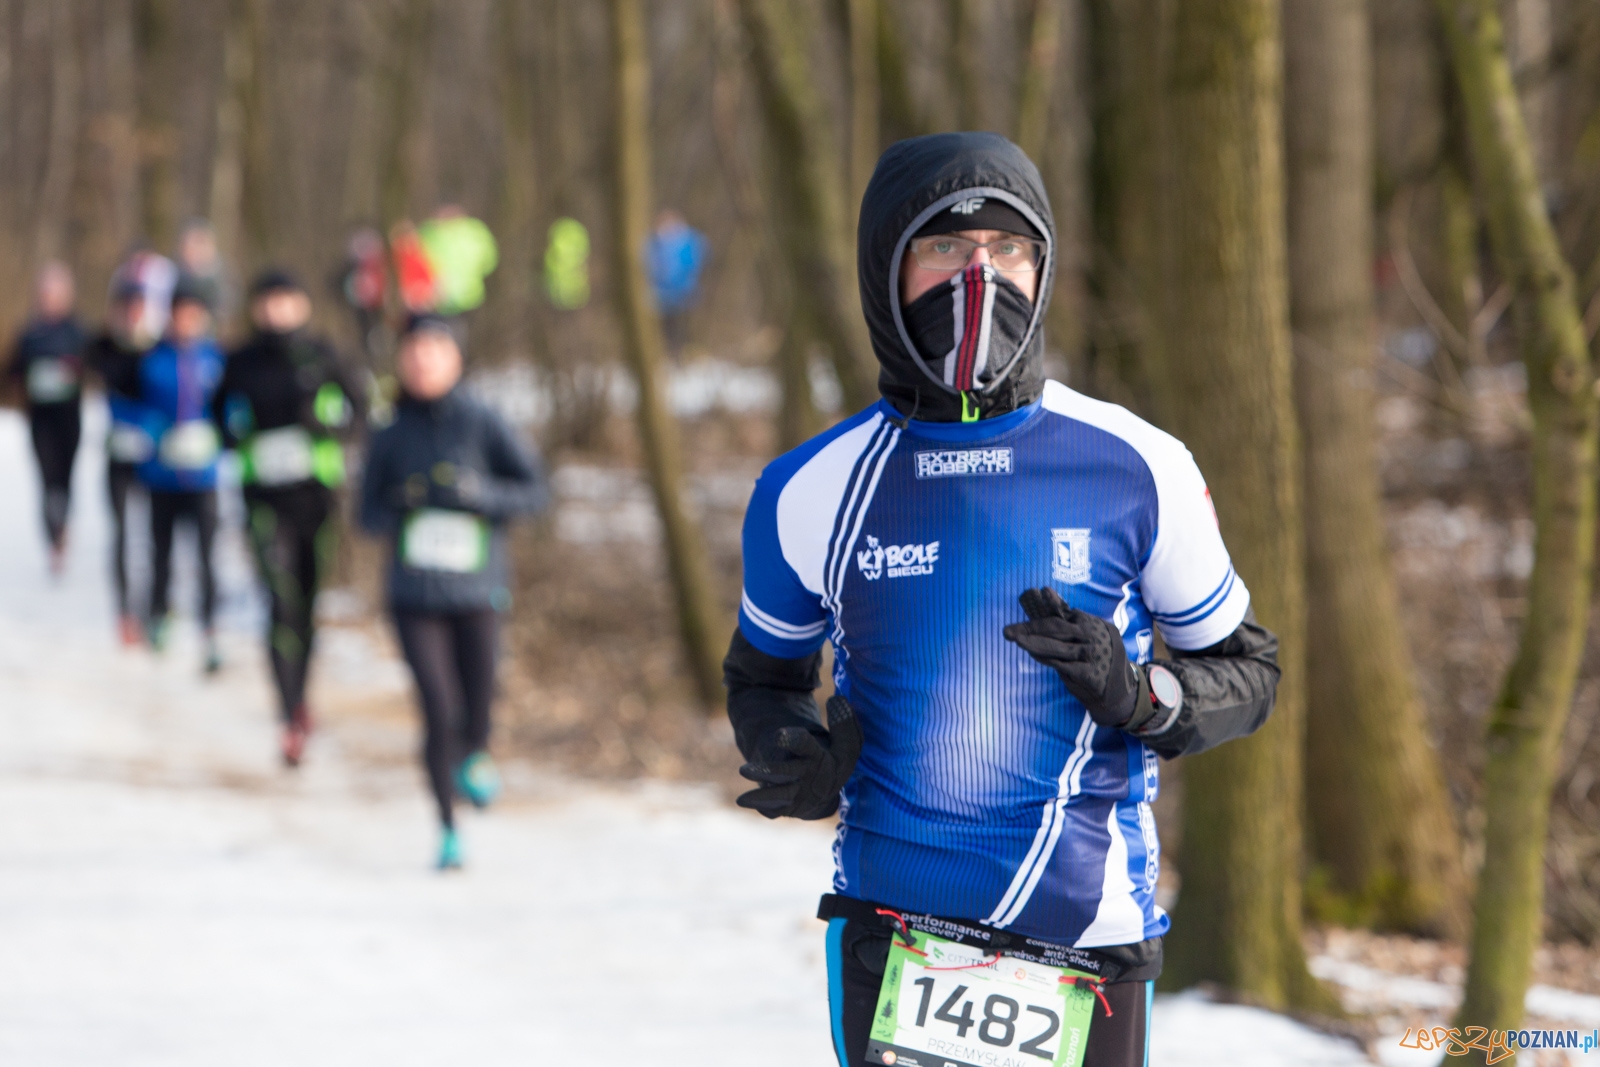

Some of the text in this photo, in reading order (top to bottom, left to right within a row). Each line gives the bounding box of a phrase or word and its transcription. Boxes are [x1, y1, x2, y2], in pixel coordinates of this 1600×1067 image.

[951, 198, 986, 215] 4F
[917, 449, 1011, 463] EXTREME
[863, 568, 882, 581] W
[901, 912, 992, 941] performance
[912, 922, 964, 942] recovery
[1043, 948, 1100, 971] anti-shock
[914, 976, 1060, 1061] 1482
